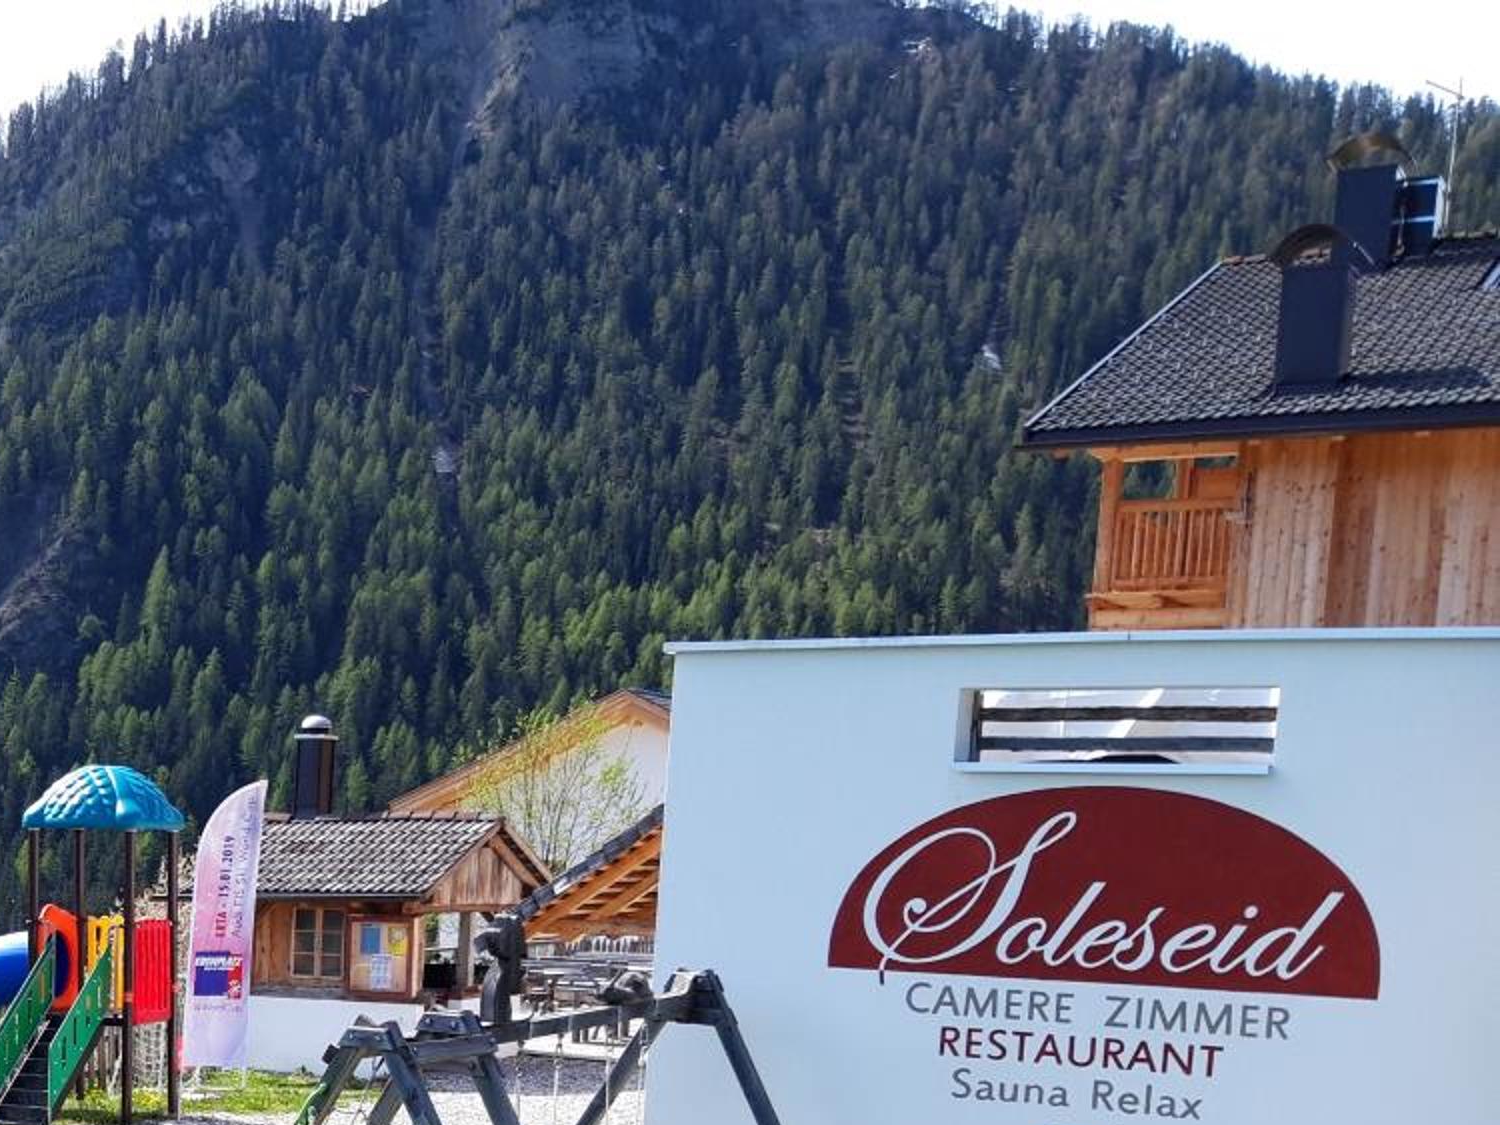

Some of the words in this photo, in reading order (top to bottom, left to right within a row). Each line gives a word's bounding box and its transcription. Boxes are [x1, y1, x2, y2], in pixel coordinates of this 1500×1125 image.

[863, 811, 1345, 985] Soleseid
[905, 981, 1075, 1024] CAMERE
[1104, 995, 1291, 1040] ZIMMER
[938, 1026, 1224, 1077] RESTAURANT
[951, 1068, 1070, 1107] Sauna
[1091, 1080, 1203, 1120] Relax
